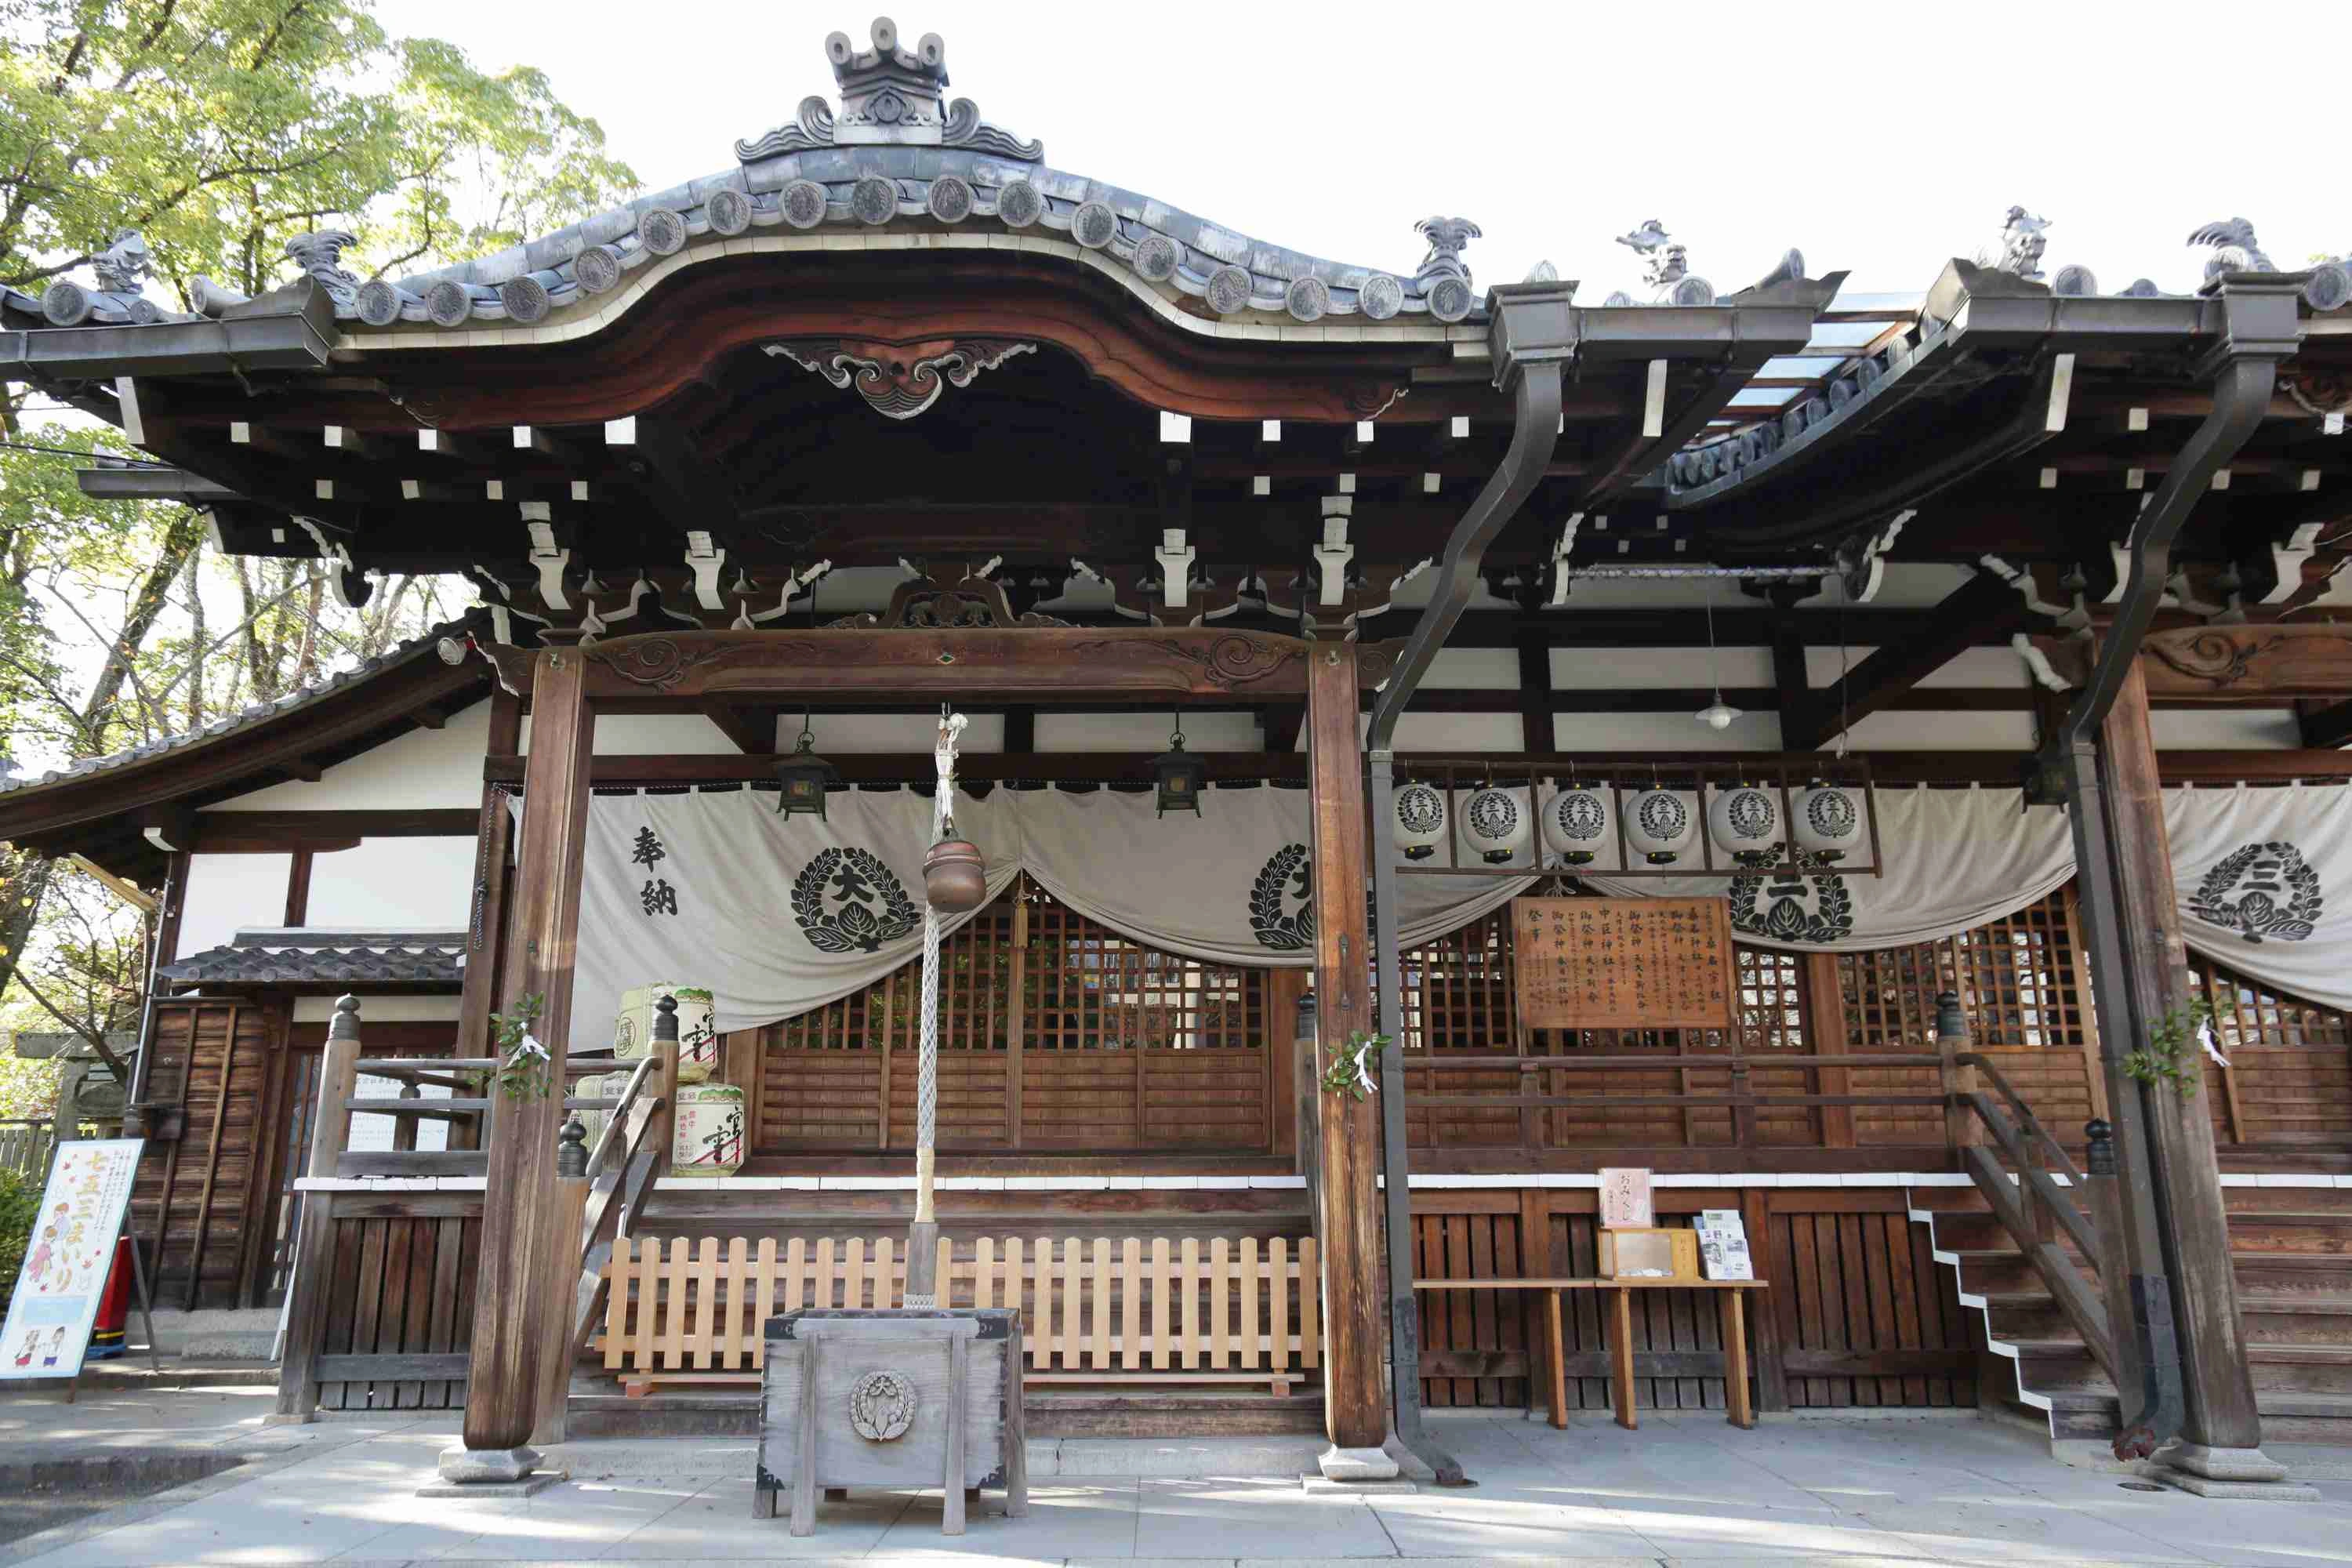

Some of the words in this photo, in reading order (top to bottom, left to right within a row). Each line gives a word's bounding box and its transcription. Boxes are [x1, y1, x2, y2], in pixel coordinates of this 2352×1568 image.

[632, 826, 679, 916] 奉納
[831, 864, 875, 902] 大
[2241, 860, 2281, 892] 三
[56, 1149, 108, 1292] 七五三まいり
[1620, 1175, 1631, 1221] おみくじ
